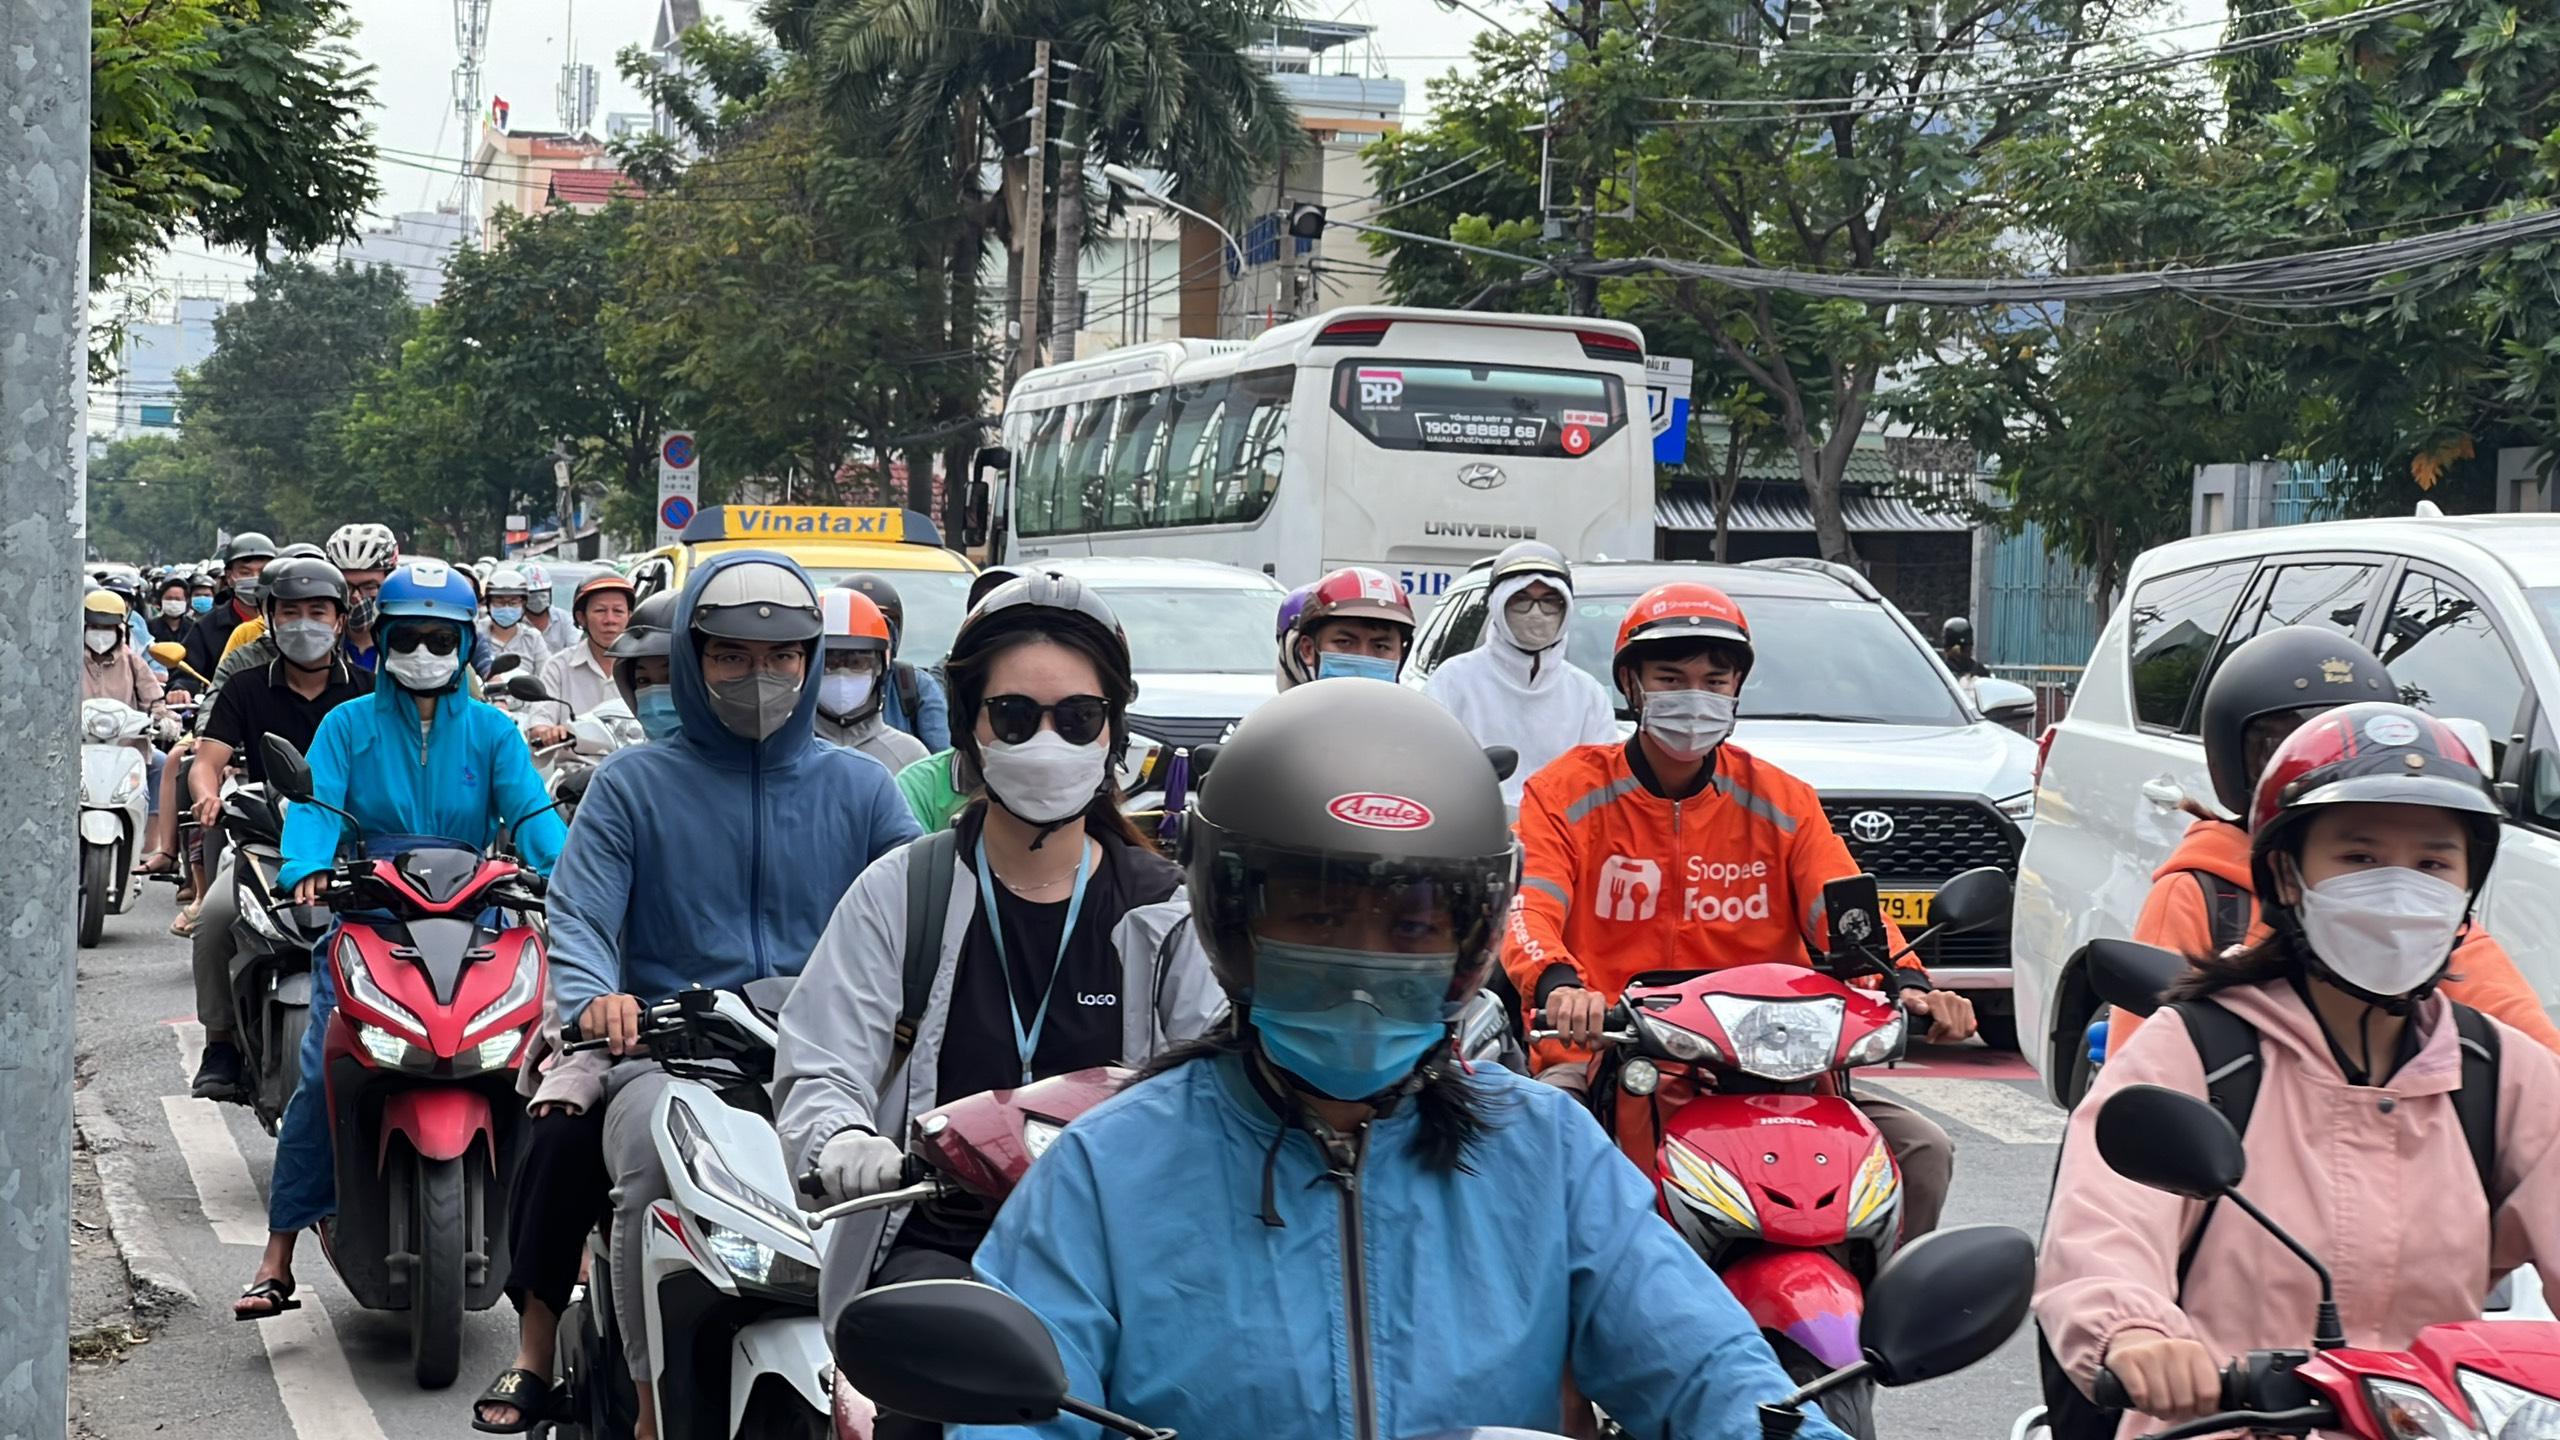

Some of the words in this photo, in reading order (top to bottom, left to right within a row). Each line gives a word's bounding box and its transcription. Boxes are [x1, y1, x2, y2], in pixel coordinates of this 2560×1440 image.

[1425, 421, 1461, 434] 1900
[1465, 423, 1510, 437] 8888
[1514, 426, 1536, 438] 68
[1569, 429, 1583, 448] 6
[738, 510, 889, 533] Vinataxi
[1424, 521, 1537, 540] UNIVERSE
[1683, 883, 1769, 922] Food
[1879, 898, 1934, 919] 79.1
[1077, 991, 1116, 1006] LOGO
[1760, 1116, 1818, 1128] HONDA
[493, 1372, 521, 1394] NY
